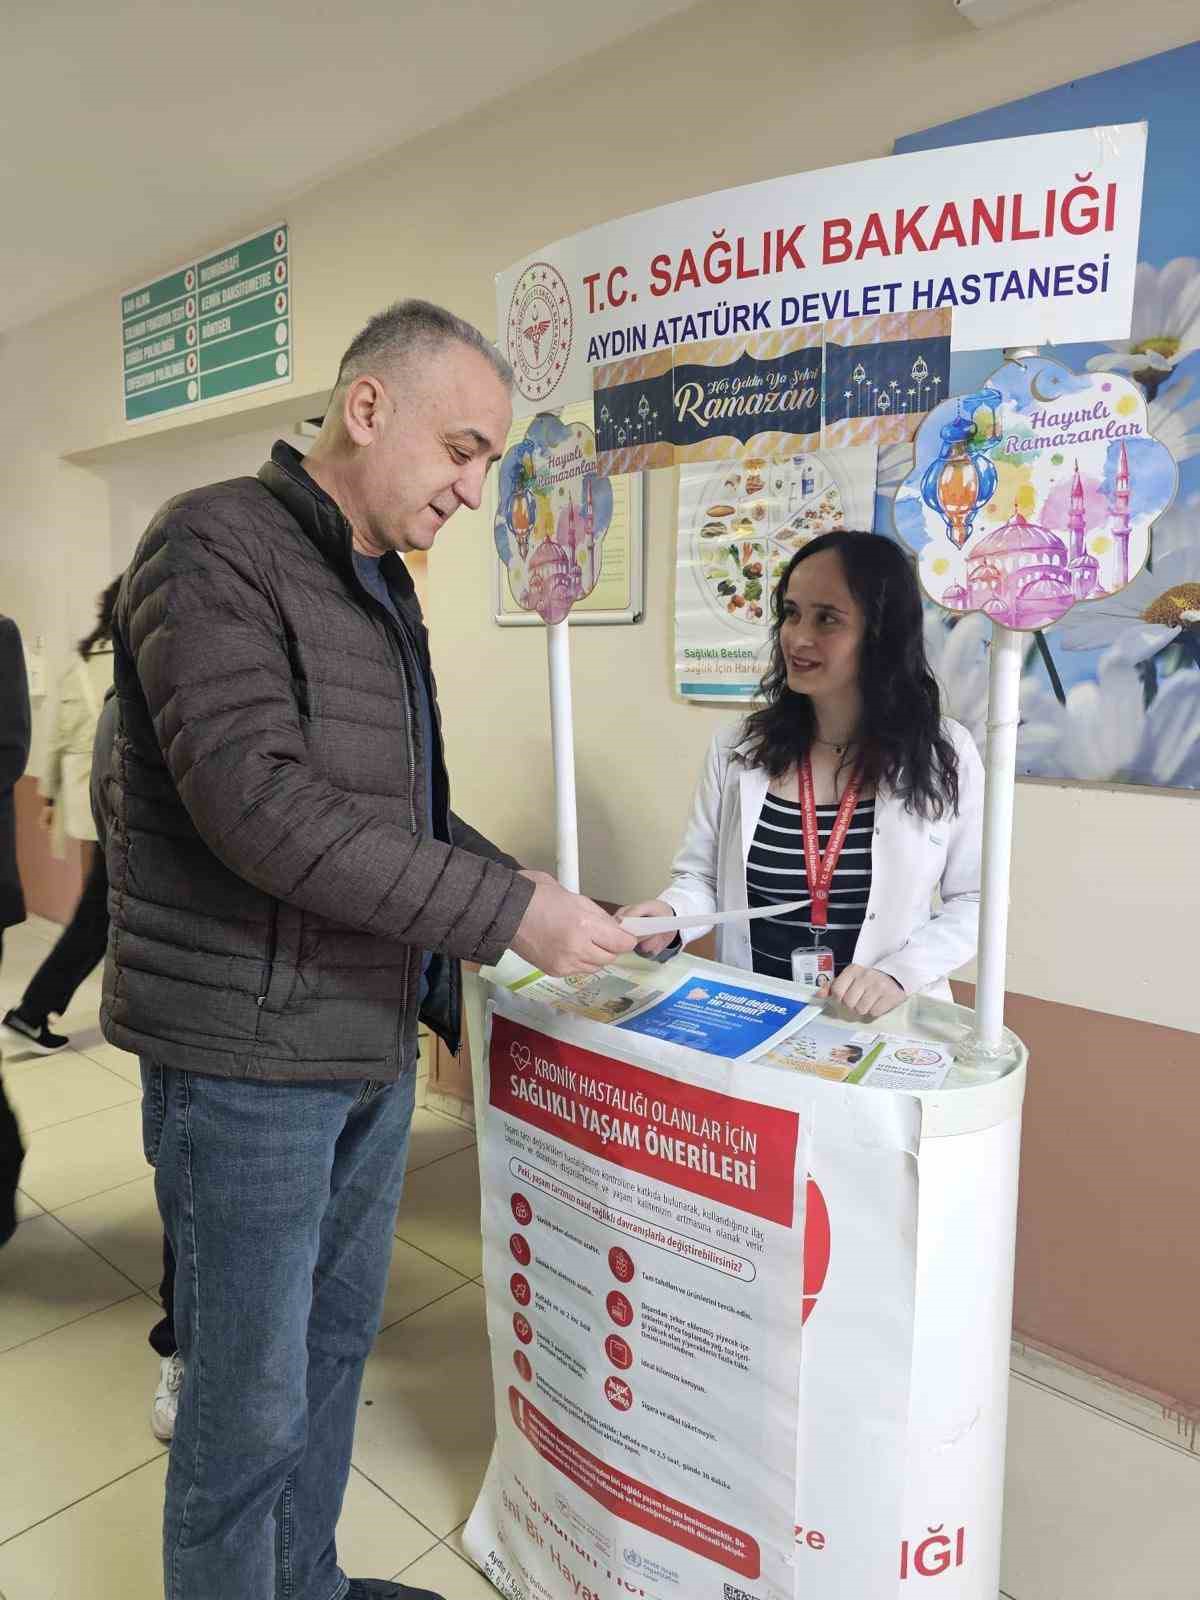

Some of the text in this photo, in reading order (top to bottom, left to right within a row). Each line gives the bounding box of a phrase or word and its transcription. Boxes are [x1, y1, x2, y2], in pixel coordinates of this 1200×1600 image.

[582, 171, 1117, 314] T.C. SAĞLIK BAKANLIĞI
[586, 323, 647, 363] AYDIN
[652, 299, 771, 348] ATATÜRK
[781, 282, 902, 327] DEVLET
[912, 253, 1110, 310] HASTANESİ
[674, 382, 819, 427] Ramazan
[1031, 401, 1110, 432] Hayırlı
[548, 445, 583, 469] Hayırlı
[1005, 422, 1142, 454] Ramazanlar
[537, 461, 597, 487] Ramazanlar
[684, 648, 718, 660] Sağlıklı
[535, 1057, 757, 1154] KRONİK HASTALIĞI OLANLAR İÇİN
[510, 1074, 757, 1191] SAĞLIKLI YAŞAM ÖNERİLERİ
[576, 1196, 591, 1211] nasıl
[592, 1203, 616, 1224] sağlıklı
[617, 1214, 666, 1245] davranışlarla
[666, 1234, 743, 1273] değiştirebilirsiniz?
